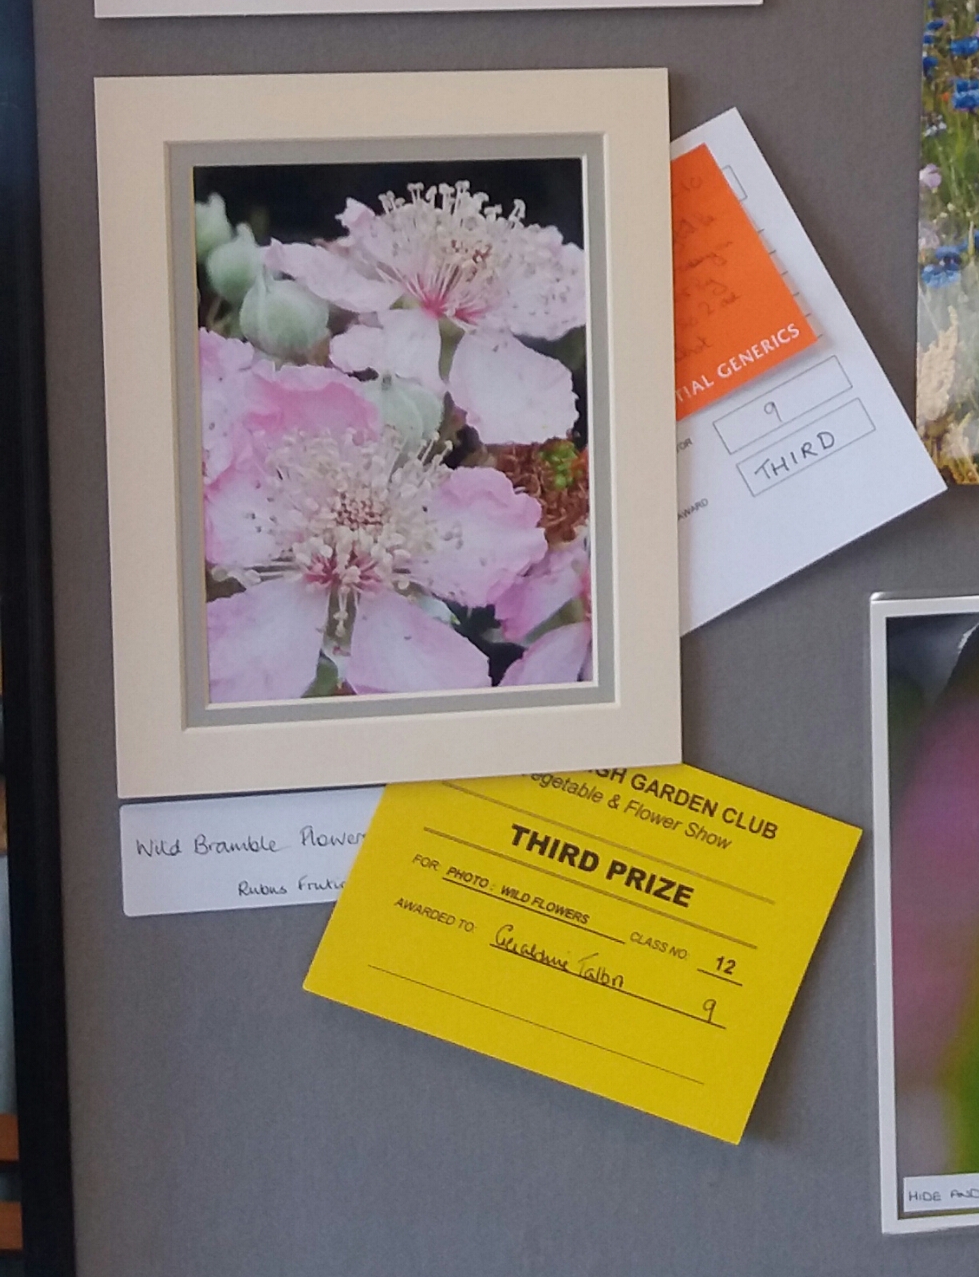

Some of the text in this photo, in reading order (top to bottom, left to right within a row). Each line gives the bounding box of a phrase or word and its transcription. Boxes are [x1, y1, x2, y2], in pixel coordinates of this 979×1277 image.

[717, 323, 801, 380] GENERICS
[763, 401, 783, 423] 9
[754, 431, 835, 480] THIRD
[524, 773, 733, 850] egetable & Flower Show
[588, 767, 779, 841] GH GARDEN CLUB
[136, 837, 183, 858] Wild
[193, 833, 285, 856] Bramble
[510, 823, 695, 908] THIRD PRIZE
[394, 897, 456, 927] AWARDED
[500, 884, 531, 904] WILD
[530, 895, 591, 925] FLOWERS
[630, 931, 668, 953] CLASS
[716, 955, 737, 975] 12
[702, 998, 718, 1024] 9
[908, 1190, 942, 1202] HIDE
